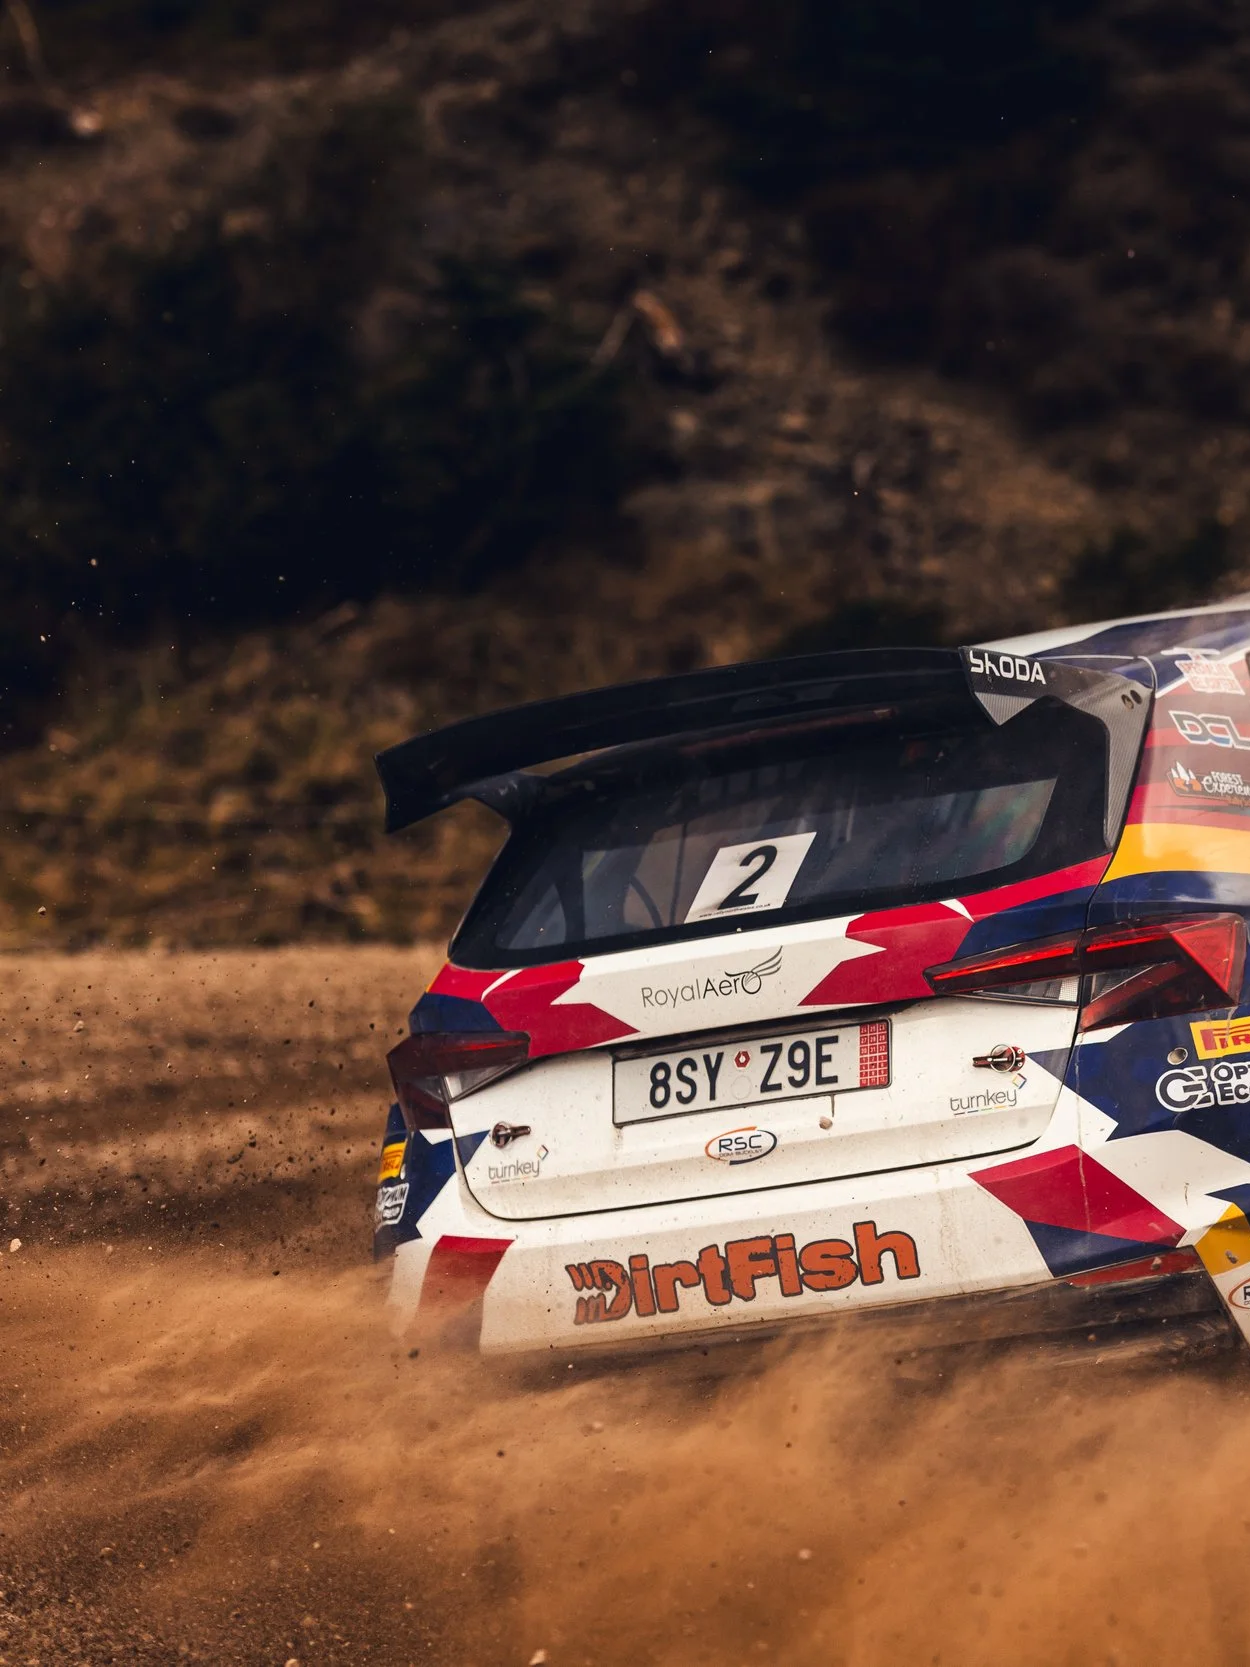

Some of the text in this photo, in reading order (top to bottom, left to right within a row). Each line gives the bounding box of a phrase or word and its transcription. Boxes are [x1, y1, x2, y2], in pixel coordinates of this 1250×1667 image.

[1211, 771, 1243, 785] FOREST
[717, 844, 778, 911] 2
[650, 1051, 725, 1109] 8SY
[760, 1035, 839, 1094] Z9E
[949, 1089, 1018, 1112] turnkey
[718, 1135, 762, 1152] RSC
[488, 1160, 540, 1180] turnkey
[565, 1220, 921, 1325] DirtFish
